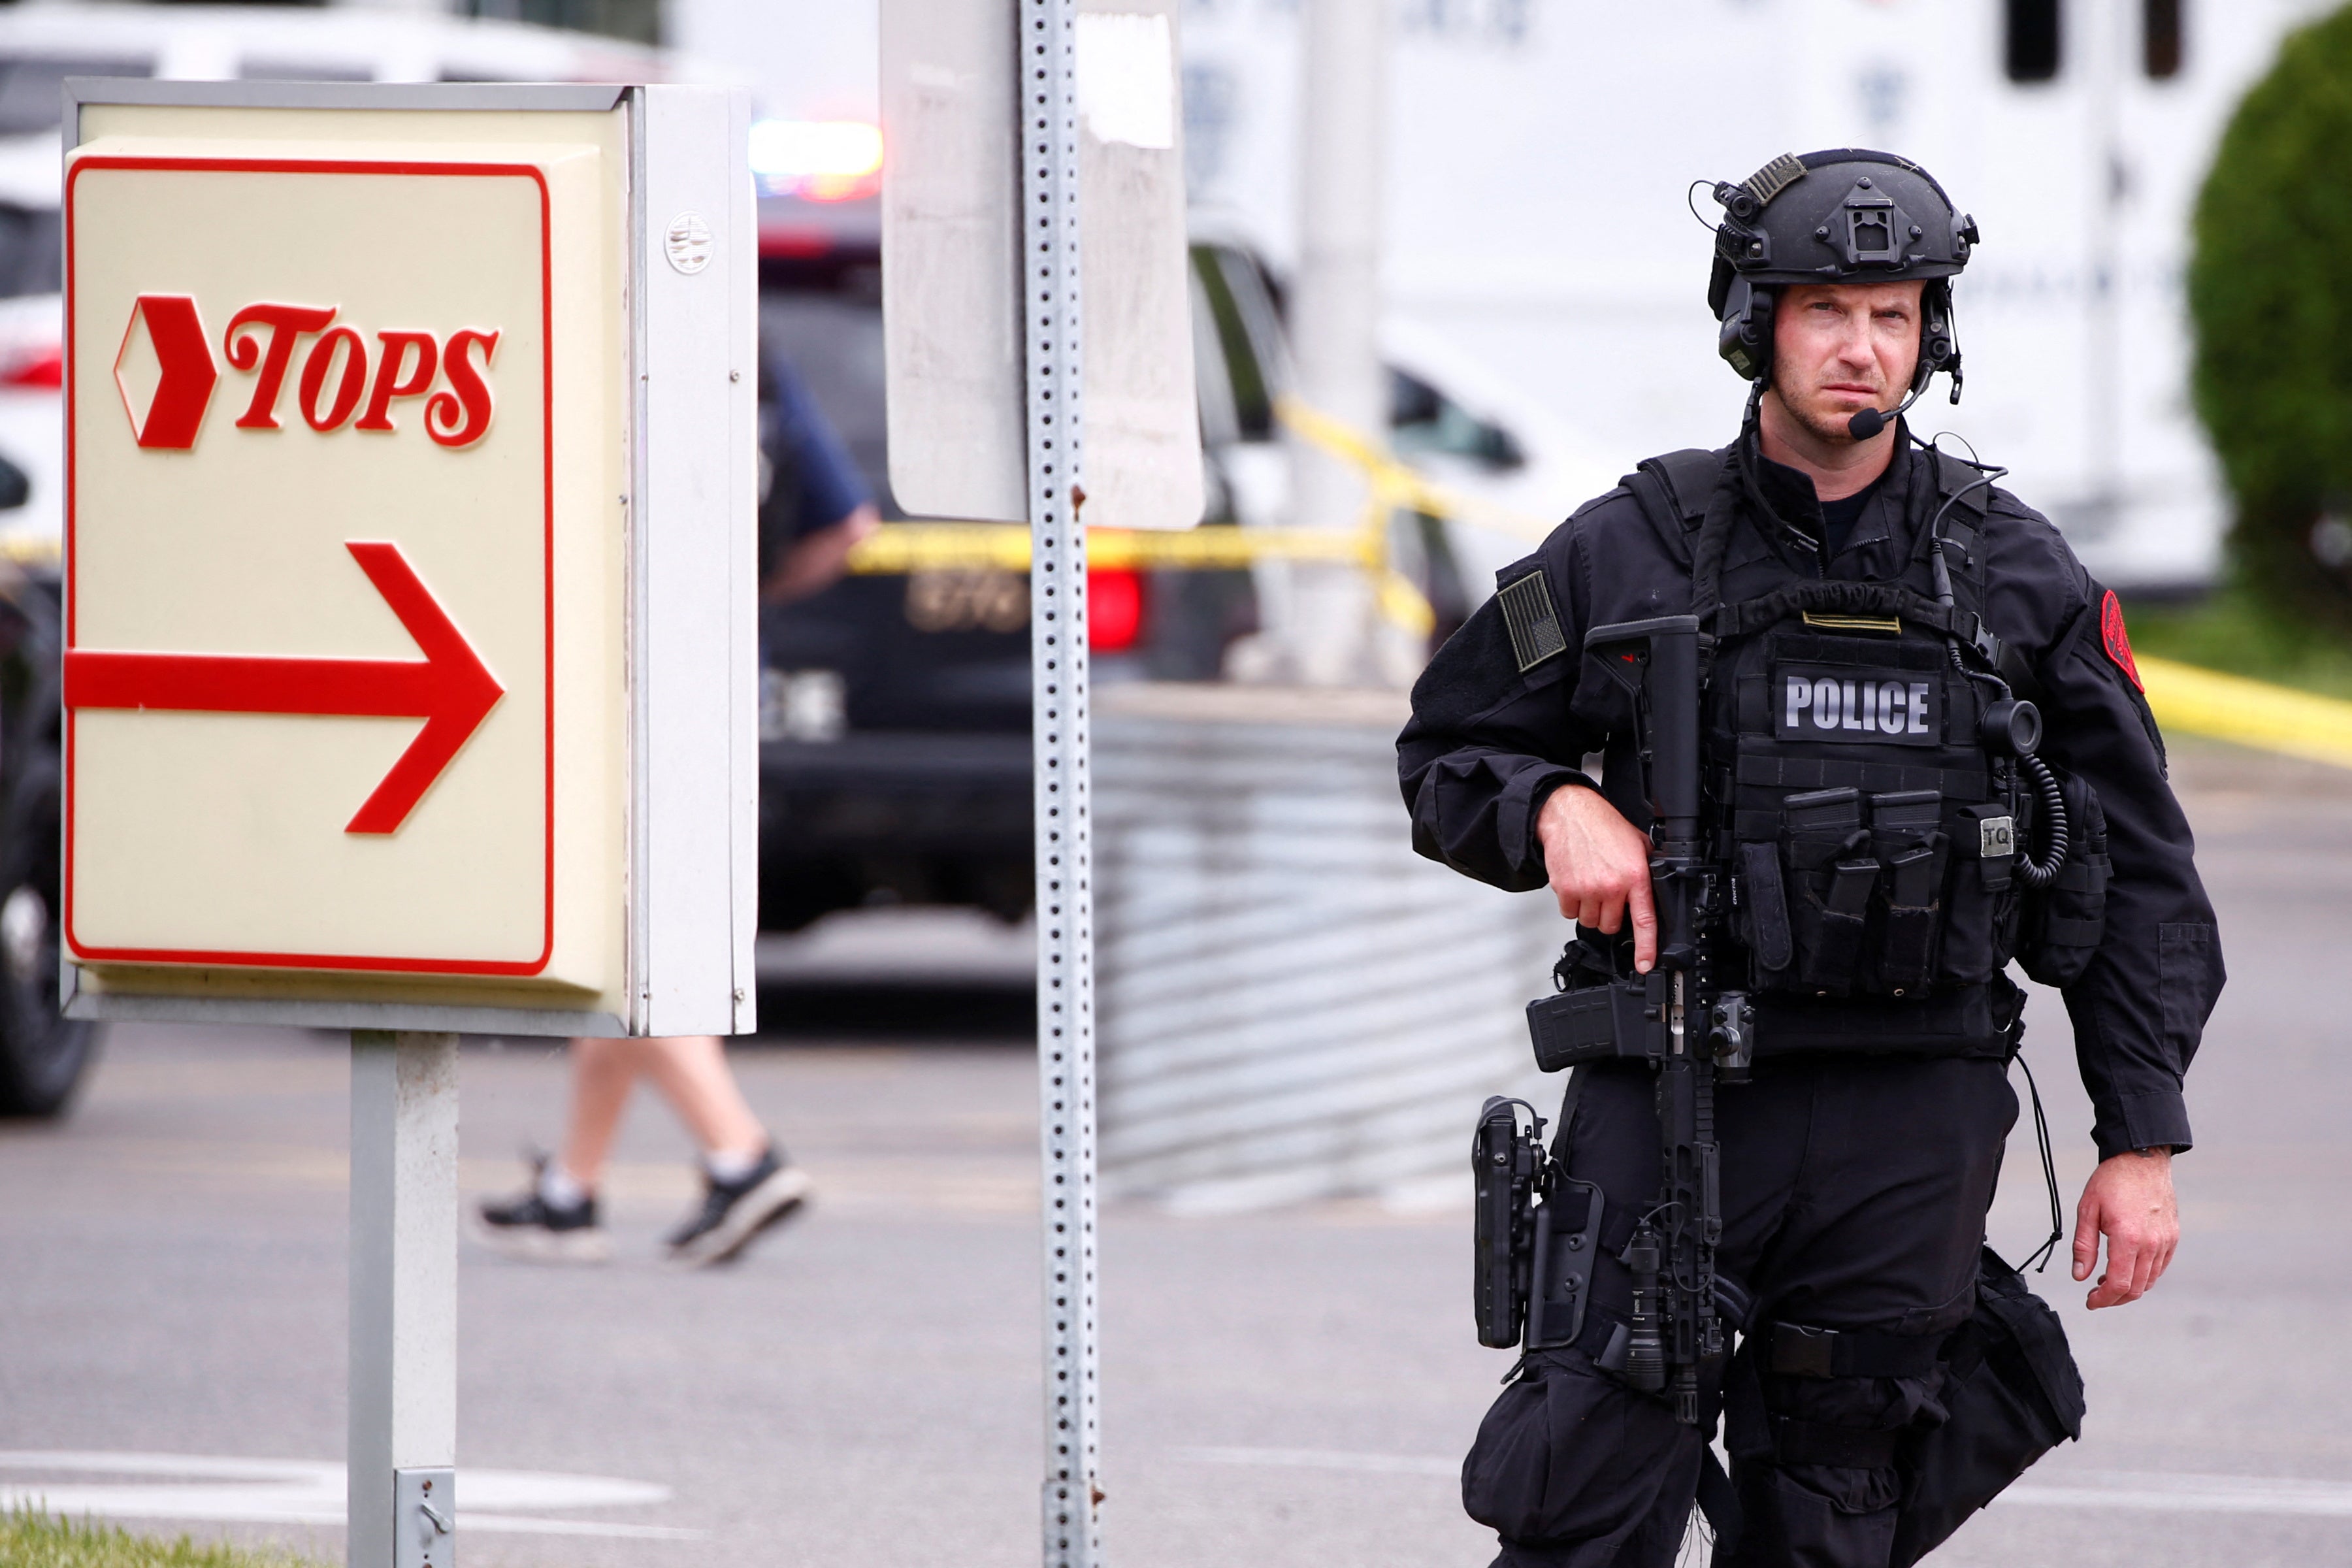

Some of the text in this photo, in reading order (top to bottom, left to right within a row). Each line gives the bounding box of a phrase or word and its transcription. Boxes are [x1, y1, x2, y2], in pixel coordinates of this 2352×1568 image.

[223, 302, 502, 448] TOPS
[1786, 676, 1929, 734] POLICE
[1984, 826, 2010, 846] TQ
